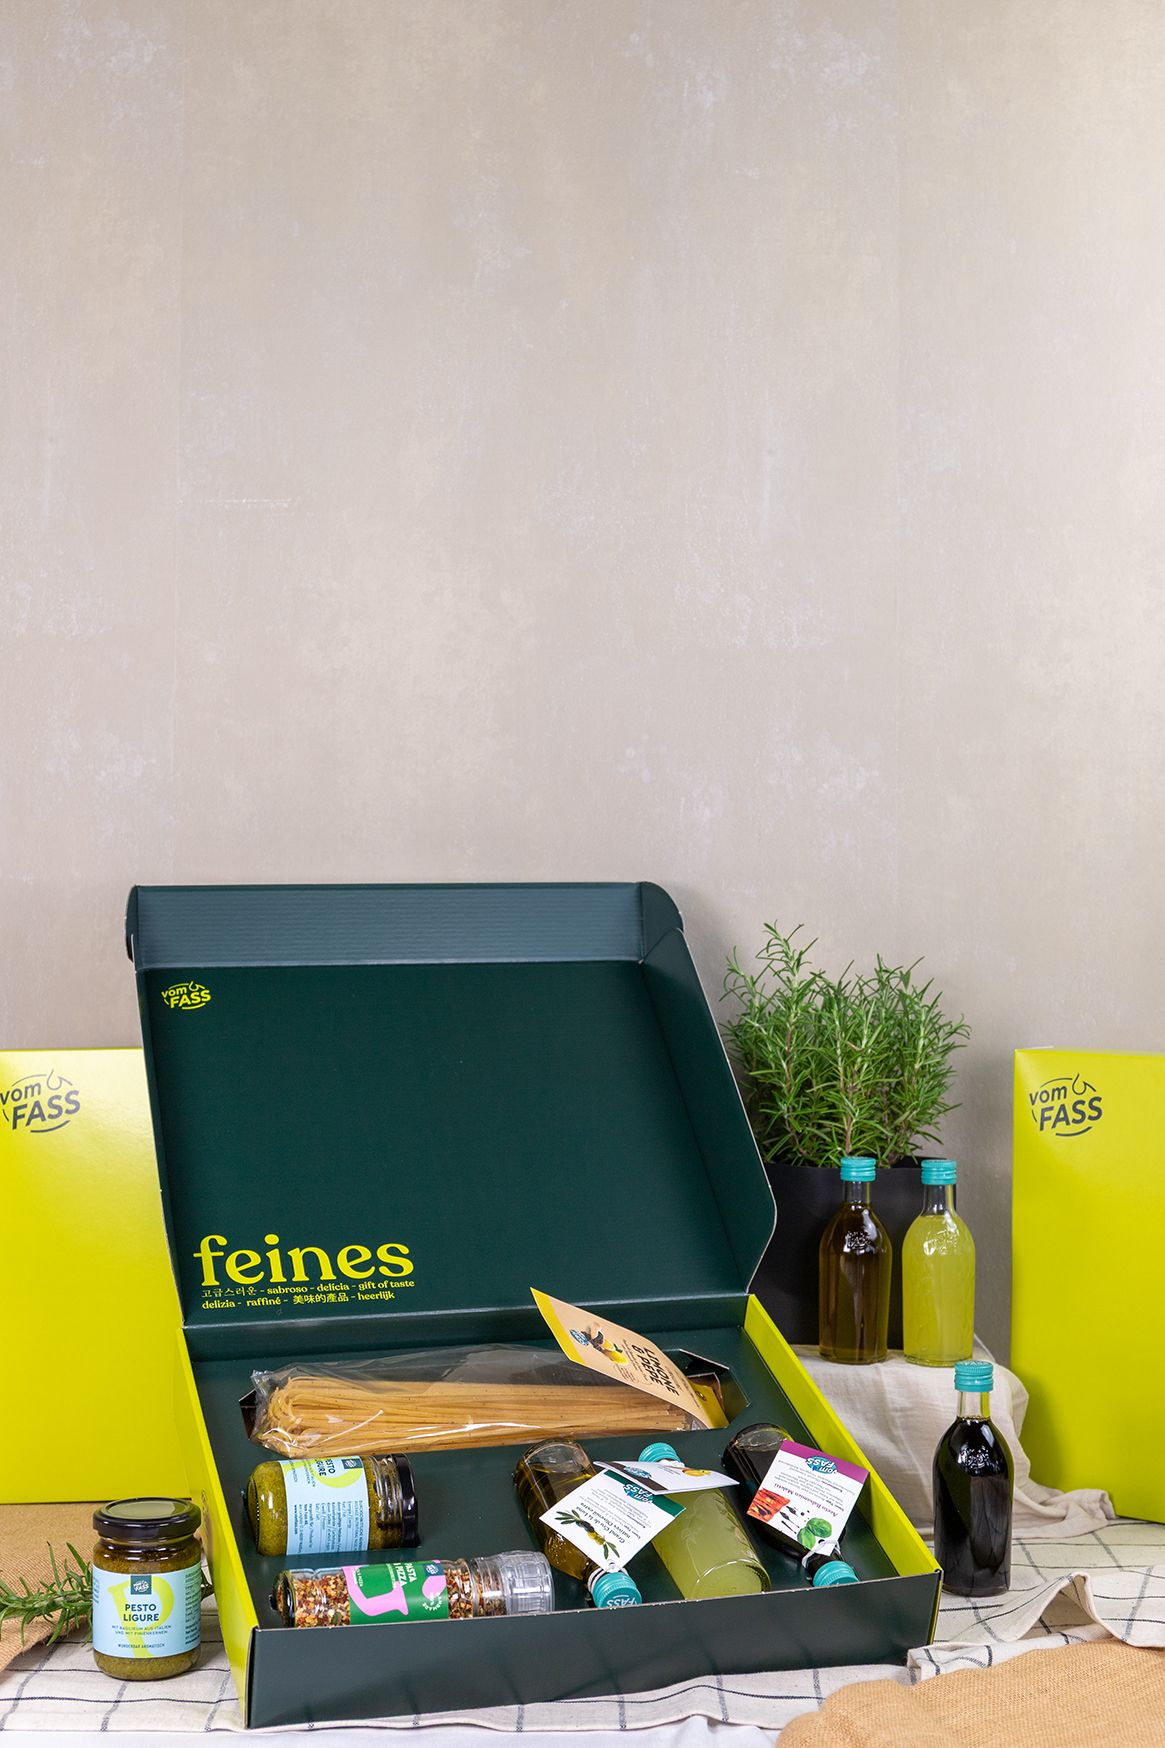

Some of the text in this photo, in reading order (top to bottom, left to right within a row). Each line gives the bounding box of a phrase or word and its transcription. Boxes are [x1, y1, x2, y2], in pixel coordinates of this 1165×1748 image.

[161, 987, 187, 998] vom
[170, 990, 211, 1008] FASS
[0, 1083, 41, 1105] vom
[1029, 1086, 1067, 1106] vom
[12, 1090, 80, 1130] FASS
[1040, 1096, 1103, 1131] FASS
[193, 1233, 414, 1286] feines
[267, 1286, 308, 1295] sabroso
[358, 1281, 376, 1291] gift
[377, 1280, 389, 1288] of
[390, 1280, 415, 1288] taste
[202, 1300, 235, 1309] delizia
[246, 1297, 281, 1307] raffiné
[357, 1291, 395, 1301] heerlijk
[639, 1354, 663, 1387] PEPE
[643, 1344, 680, 1396] LIMONE
[805, 1457, 834, 1468] FASS
[819, 1465, 837, 1474] vom
[623, 1482, 652, 1498] FASS
[633, 1493, 652, 1505] vom
[395, 1565, 407, 1586] PIZZA
[404, 1562, 417, 1582] PASTA
[125, 1604, 157, 1612] PESTO
[123, 1613, 160, 1622] LIGURE
